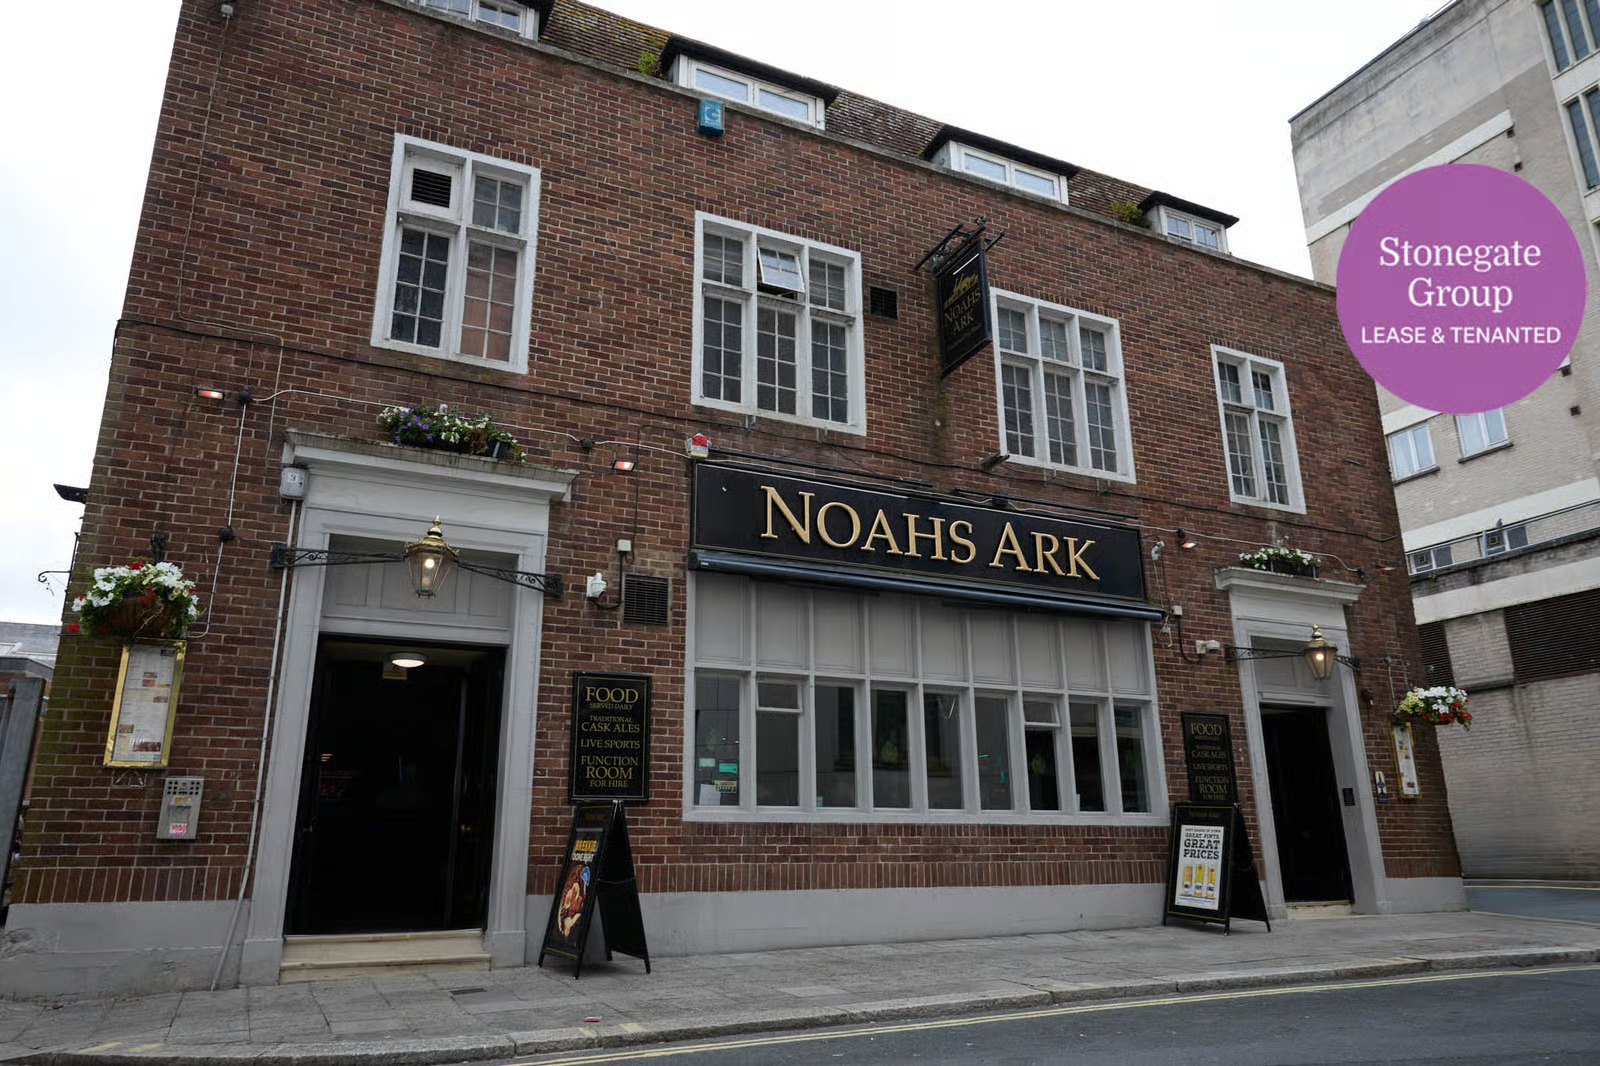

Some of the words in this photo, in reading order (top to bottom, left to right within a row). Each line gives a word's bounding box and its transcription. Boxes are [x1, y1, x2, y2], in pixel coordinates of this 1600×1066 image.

[944, 287, 981, 326] NOAHS
[953, 310, 974, 336] ARK
[760, 485, 978, 565] NOAHS
[989, 521, 1100, 581] ARK
[585, 686, 639, 704] FOOD
[589, 702, 614, 710] SERVED
[614, 703, 633, 711] DAILY
[589, 715, 633, 723] TRADITIONAL
[581, 722, 611, 732] CASK
[613, 723, 640, 733] ALES
[1190, 723, 1223, 736] FOOD
[580, 739, 603, 748] LIVE
[604, 740, 640, 749] SPORTS
[581, 755, 639, 766] FUNCTION
[585, 766, 633, 780] ROOM
[608, 780, 628, 788] HIRE
[1199, 783, 1228, 794] ROOM
[1183, 838, 1221, 850] GREAT
[1183, 848, 1220, 860] PRICES
